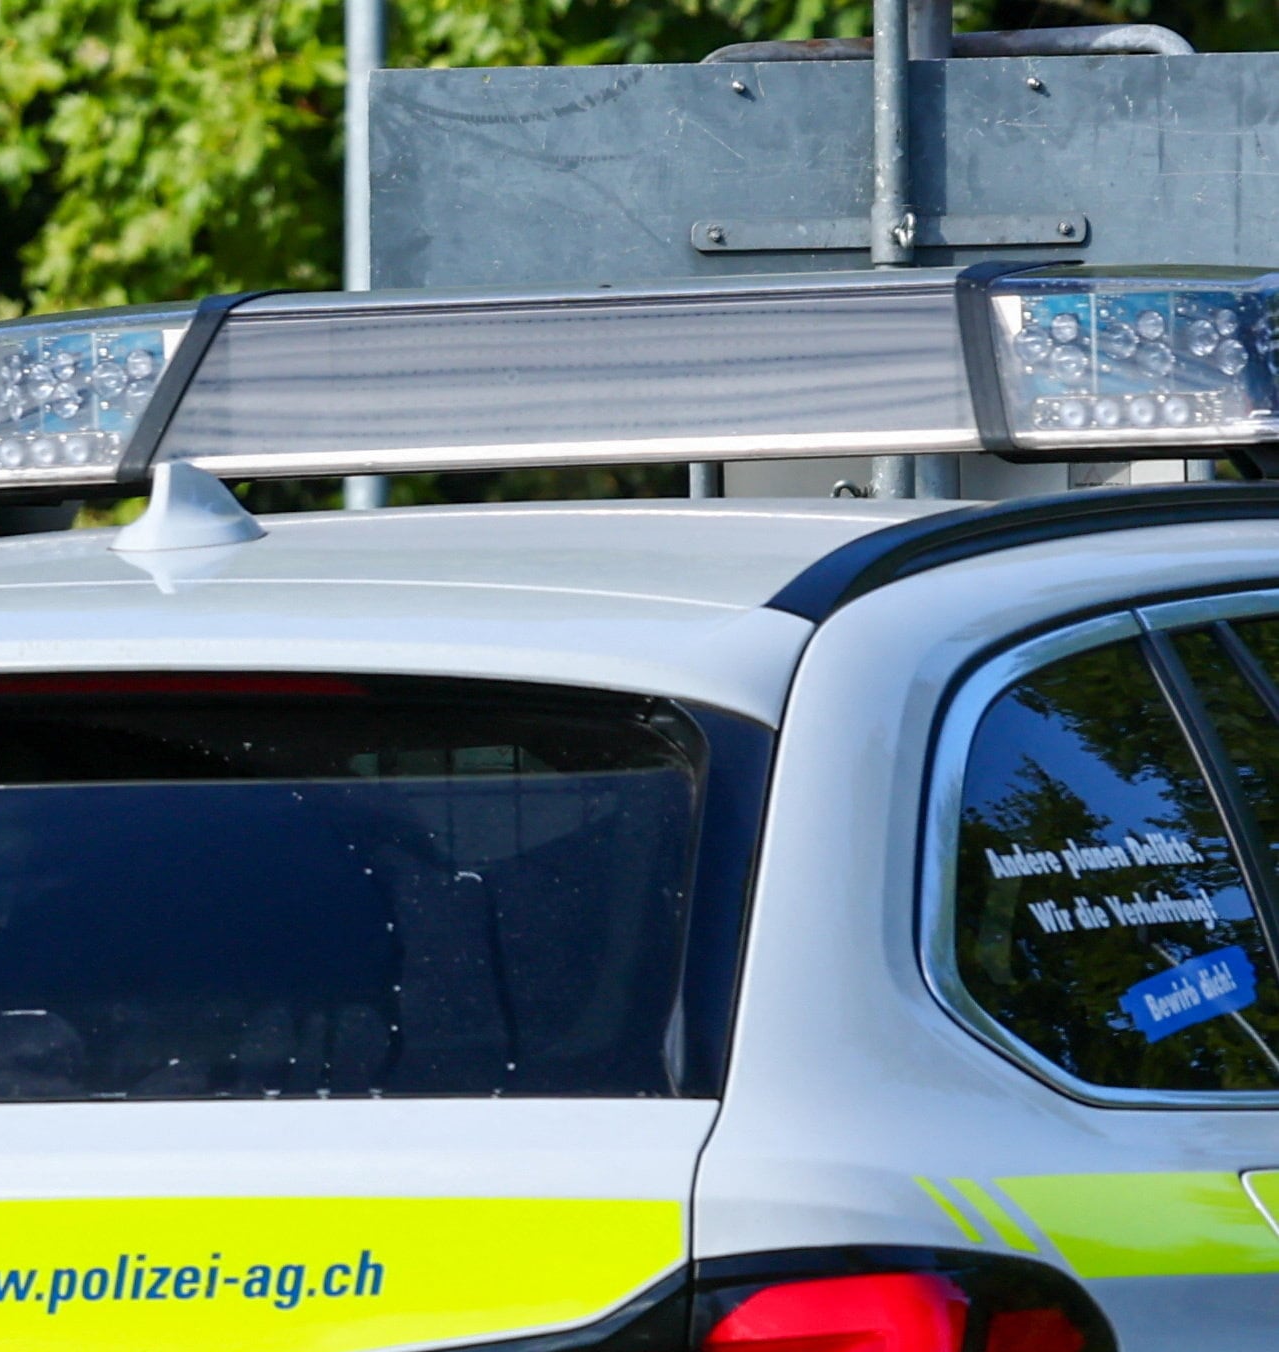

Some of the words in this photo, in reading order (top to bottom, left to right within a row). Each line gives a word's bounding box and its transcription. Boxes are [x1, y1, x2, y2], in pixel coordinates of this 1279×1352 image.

[985, 843, 1063, 879] Andere
[1061, 838, 1132, 880] planen
[1027, 899, 1074, 933] Wir
[1073, 896, 1110, 929] die
